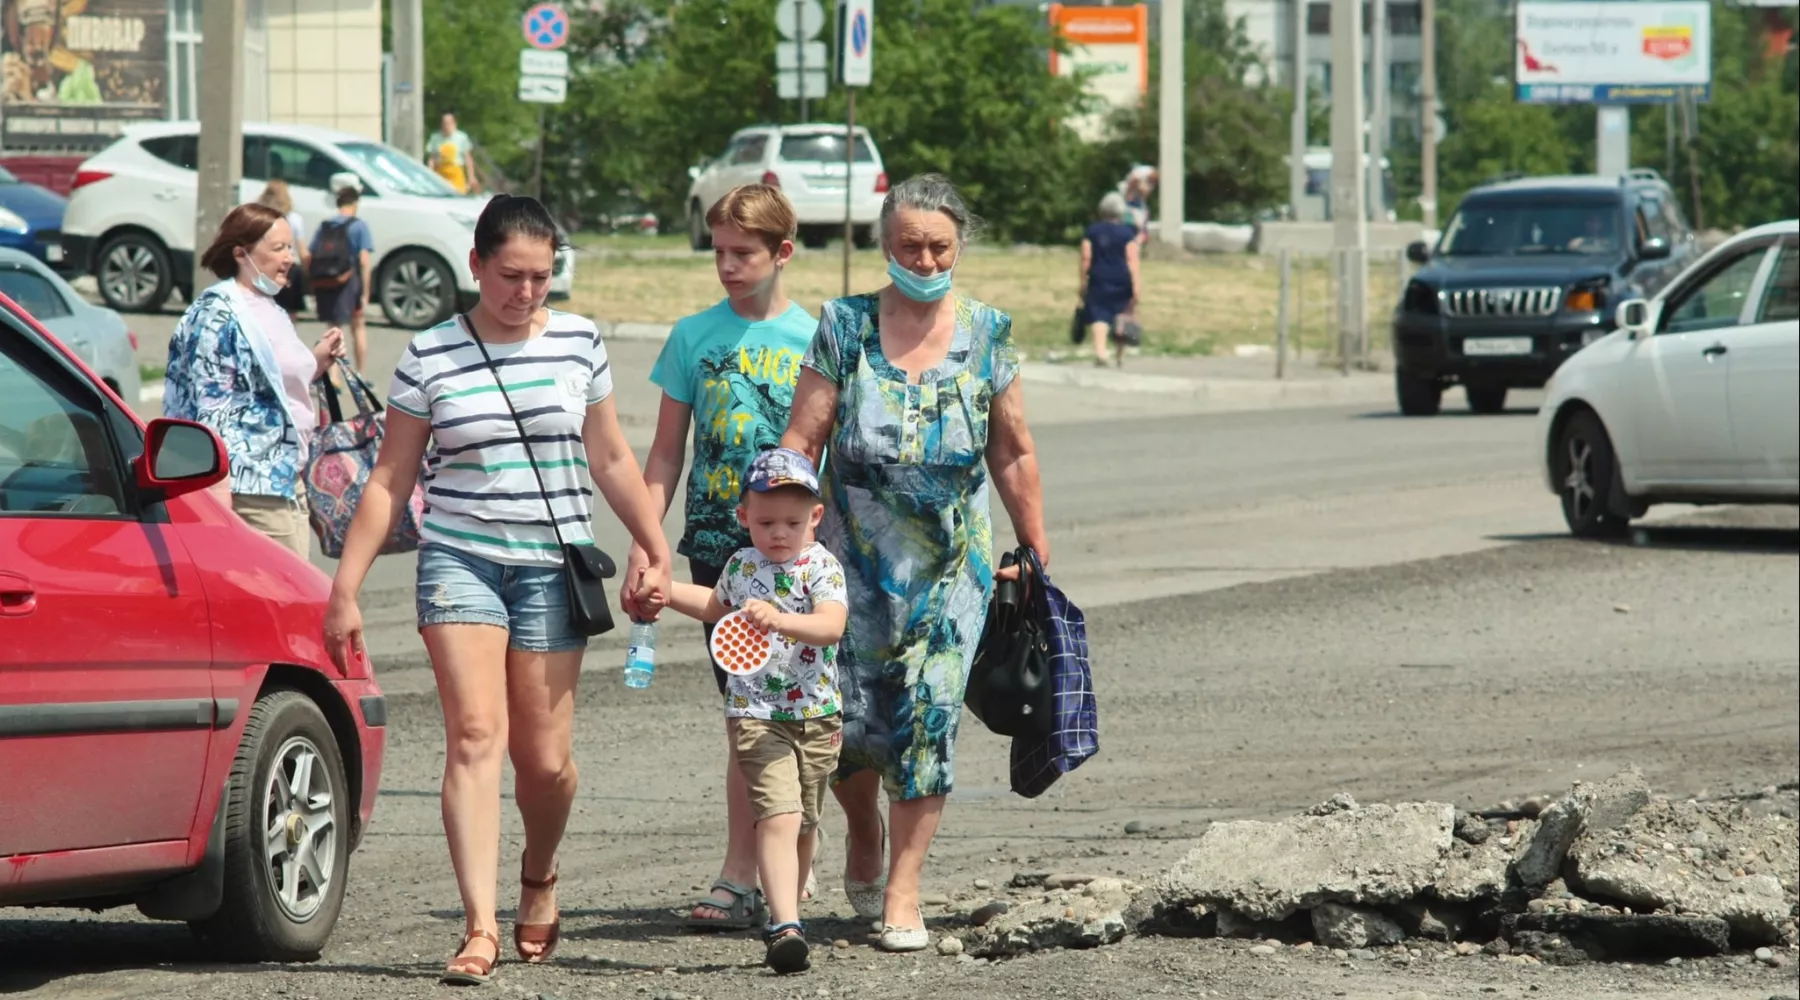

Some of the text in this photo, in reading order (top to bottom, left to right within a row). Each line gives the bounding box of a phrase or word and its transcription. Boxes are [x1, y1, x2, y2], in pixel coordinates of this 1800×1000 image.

[66, 16, 145, 52] ПИВОВАР
[740, 346, 803, 386] NICE
[704, 379, 730, 405] TO
